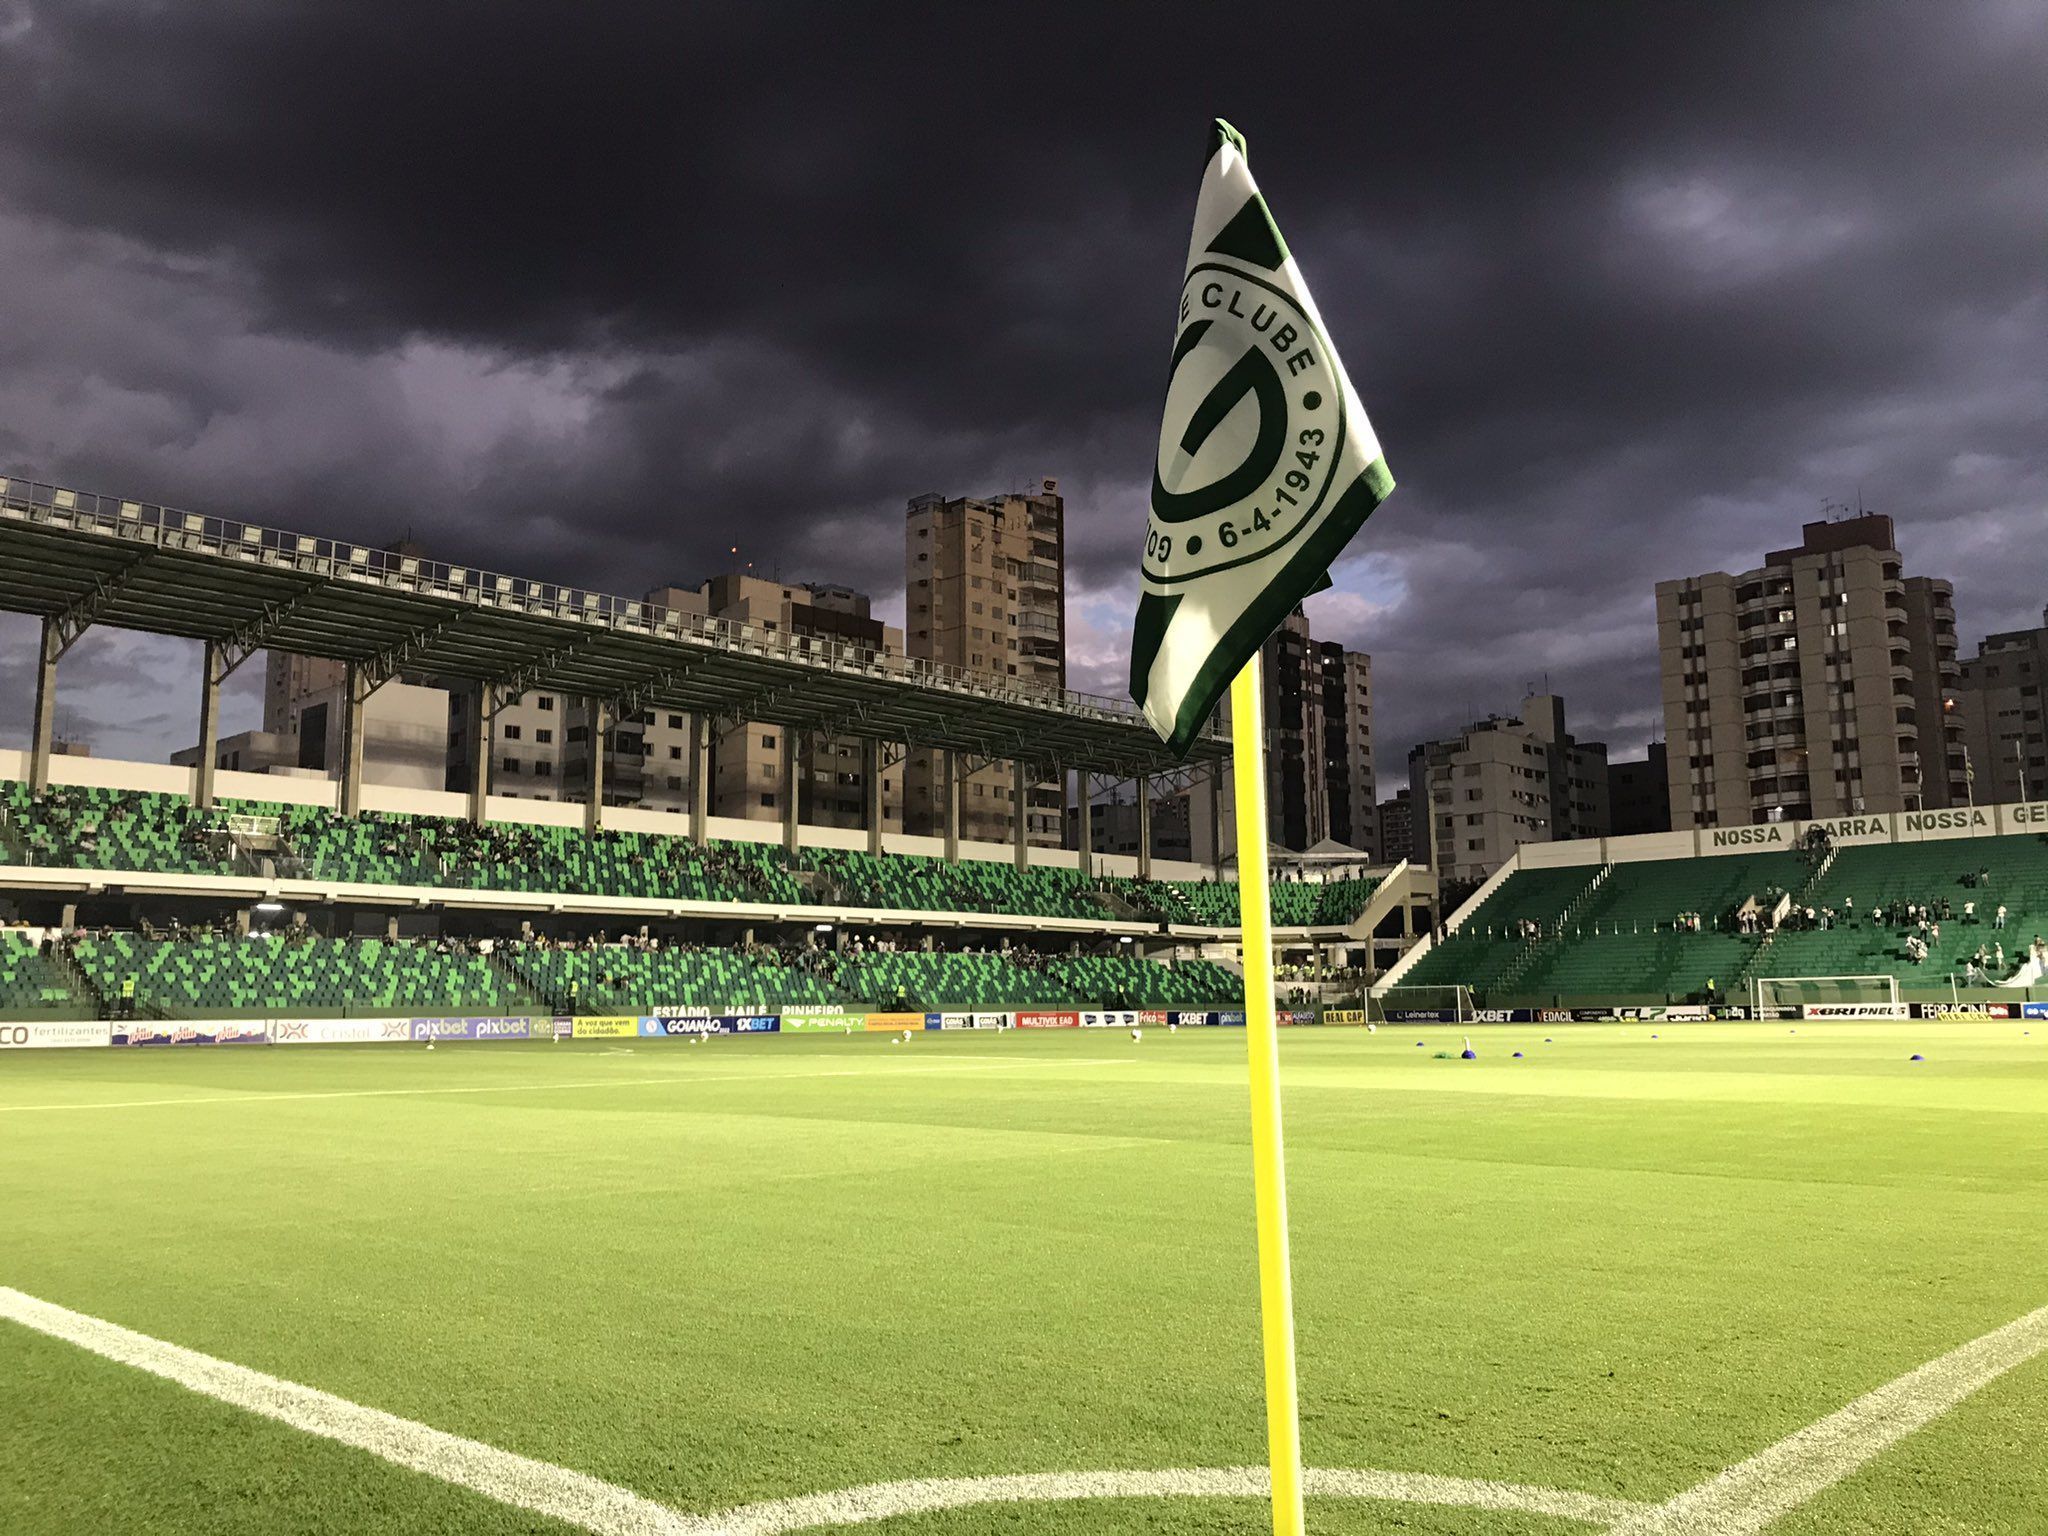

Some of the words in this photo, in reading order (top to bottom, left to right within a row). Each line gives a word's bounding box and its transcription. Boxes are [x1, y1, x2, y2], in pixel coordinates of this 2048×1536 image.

[1202, 282, 1316, 378] CLUBE
[1218, 427, 1325, 548] 6-4-1943
[1713, 826, 1782, 847] NOSSA
[1906, 809, 1987, 831] NOSSA
[2013, 804, 2048, 823] GE
[652, 1004, 710, 1018] ESTÁDIO
[1325, 1012, 1343, 1022] REAL
[1347, 1011, 1362, 1021] CAP
[1471, 1010, 1514, 1022] 1XBET
[599, 1020, 613, 1028] que
[667, 1016, 721, 1033] GOIANÃO
[736, 1018, 774, 1031] 1XBET
[808, 1018, 863, 1027] PENALTY
[1022, 1016, 1057, 1025] MULTIVIX
[1178, 1012, 1208, 1025] 1XBET
[34, 1026, 108, 1037] fertilizantes
[415, 1019, 468, 1040] pixbet
[476, 1018, 527, 1038] pixbet
